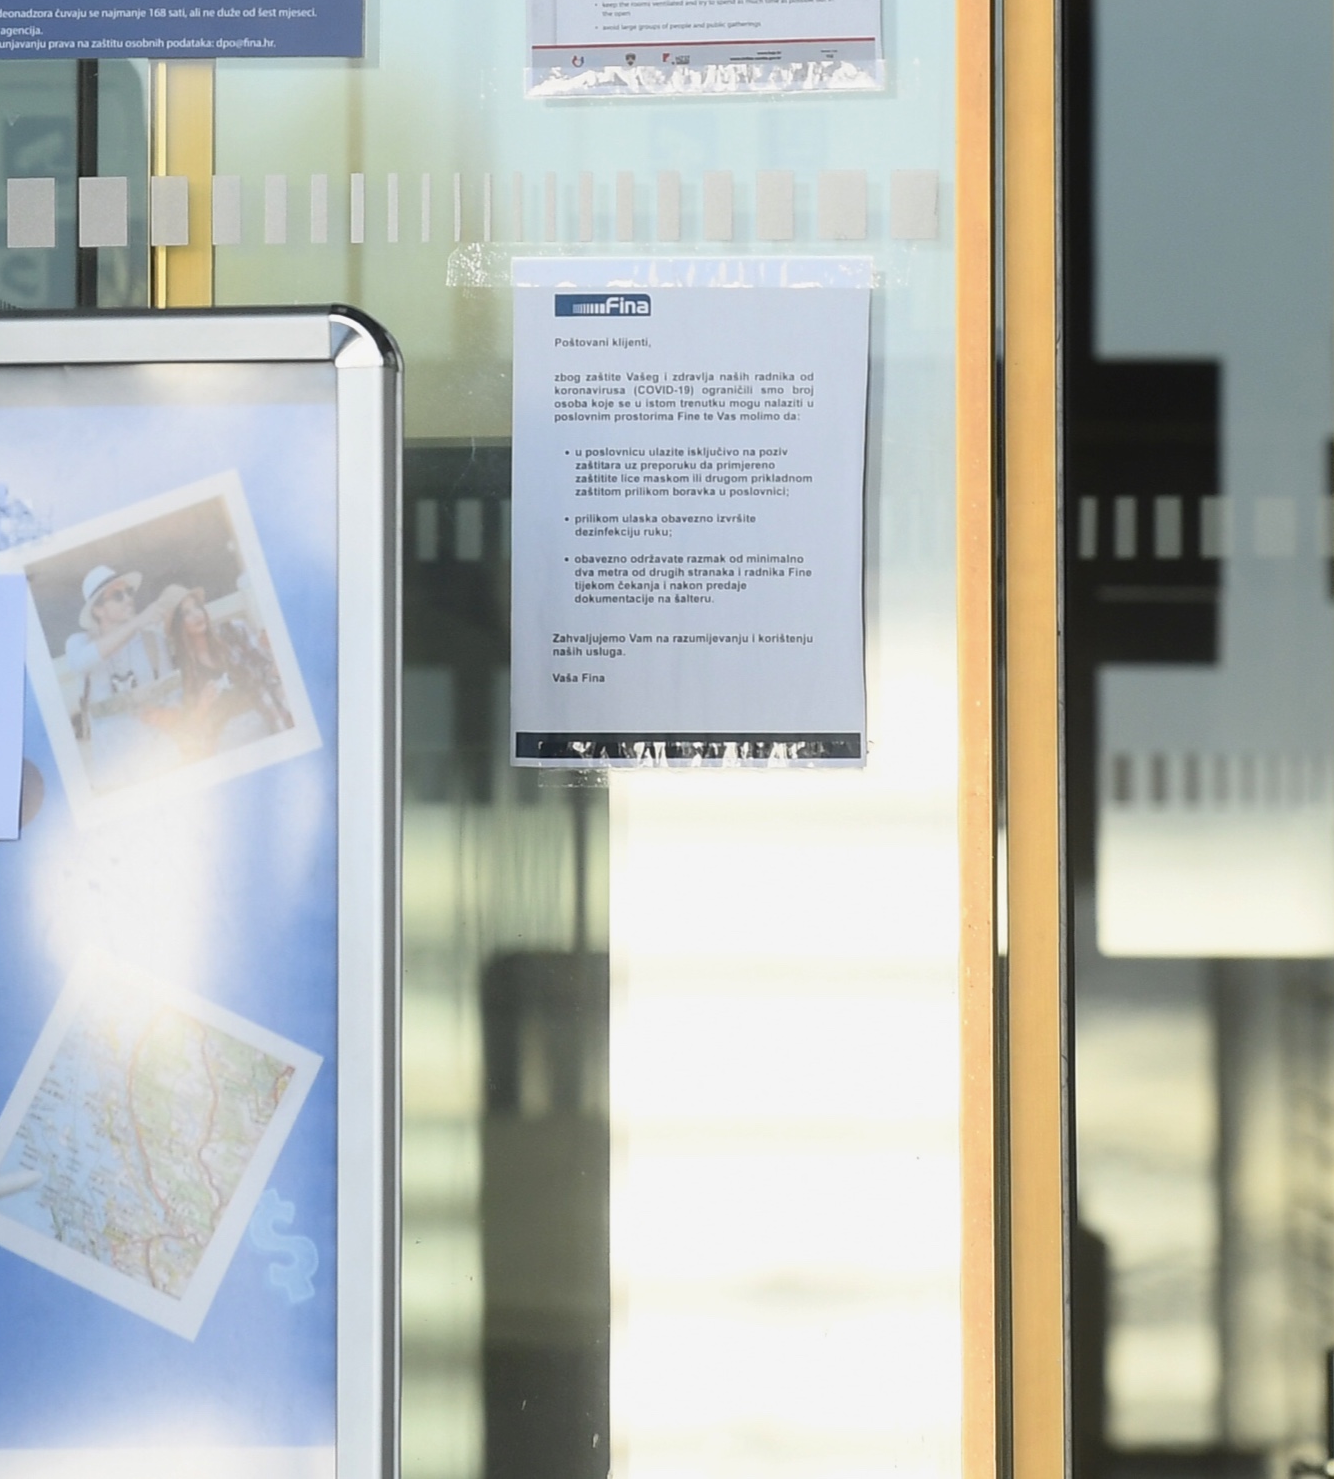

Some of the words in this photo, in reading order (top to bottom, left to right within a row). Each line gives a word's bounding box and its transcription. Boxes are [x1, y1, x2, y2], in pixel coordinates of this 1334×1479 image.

[0, 25, 43, 37] agencija.
[606, 296, 650, 315] Fina
[554, 337, 608, 347] Poštovani
[612, 337, 651, 349] klijenti,
[554, 372, 580, 384] zbog
[585, 371, 621, 381] zaštite
[626, 371, 659, 383] Vašeg
[664, 372, 667, 381] i
[672, 371, 714, 383] zdravlja
[719, 371, 749, 381] naših
[754, 372, 794, 381] radnika
[800, 372, 813, 381] od
[554, 385, 625, 395] koronavirusa
[633, 384, 693, 396] (COVID-19)
[701, 384, 752, 396] ograničili
[792, 385, 813, 397] broj
[554, 398, 587, 408] osoba
[591, 398, 614, 410] koje
[618, 400, 630, 408] se
[634, 400, 641, 408] u
[645, 398, 676, 407] istom
[680, 398, 725, 408] trenutku
[729, 400, 760, 410] mogu
[764, 398, 803, 407] nalaziti
[554, 411, 610, 423] poslovnim
[614, 411, 673, 423] prostorima
[677, 411, 700, 421] Fine
[703, 412, 713, 420] te
[716, 411, 736, 421] Vas
[739, 411, 780, 420] molimo
[783, 411, 799, 420] da:
[585, 446, 645, 458] poslovnicu
[648, 447, 684, 456] ulazite
[687, 446, 739, 458] isključivo
[742, 448, 755, 456] na
[758, 447, 788, 458] poziv
[575, 460, 621, 470] zaštitara
[624, 462, 637, 470] uz
[640, 460, 696, 472] preporuku
[699, 460, 713, 469] da
[716, 460, 775, 472] primjereno
[552, 632, 626, 645] Zahvaljujemo
[628, 633, 652, 642] Vam
[655, 635, 669, 643] na
[672, 633, 748, 645] razumijevanju
[751, 633, 755, 643] i
[758, 633, 813, 645] korištenju
[552, 646, 582, 656] naših
[585, 646, 625, 658] usluga.
[552, 672, 578, 682] Vaša
[581, 672, 605, 682] Fina
